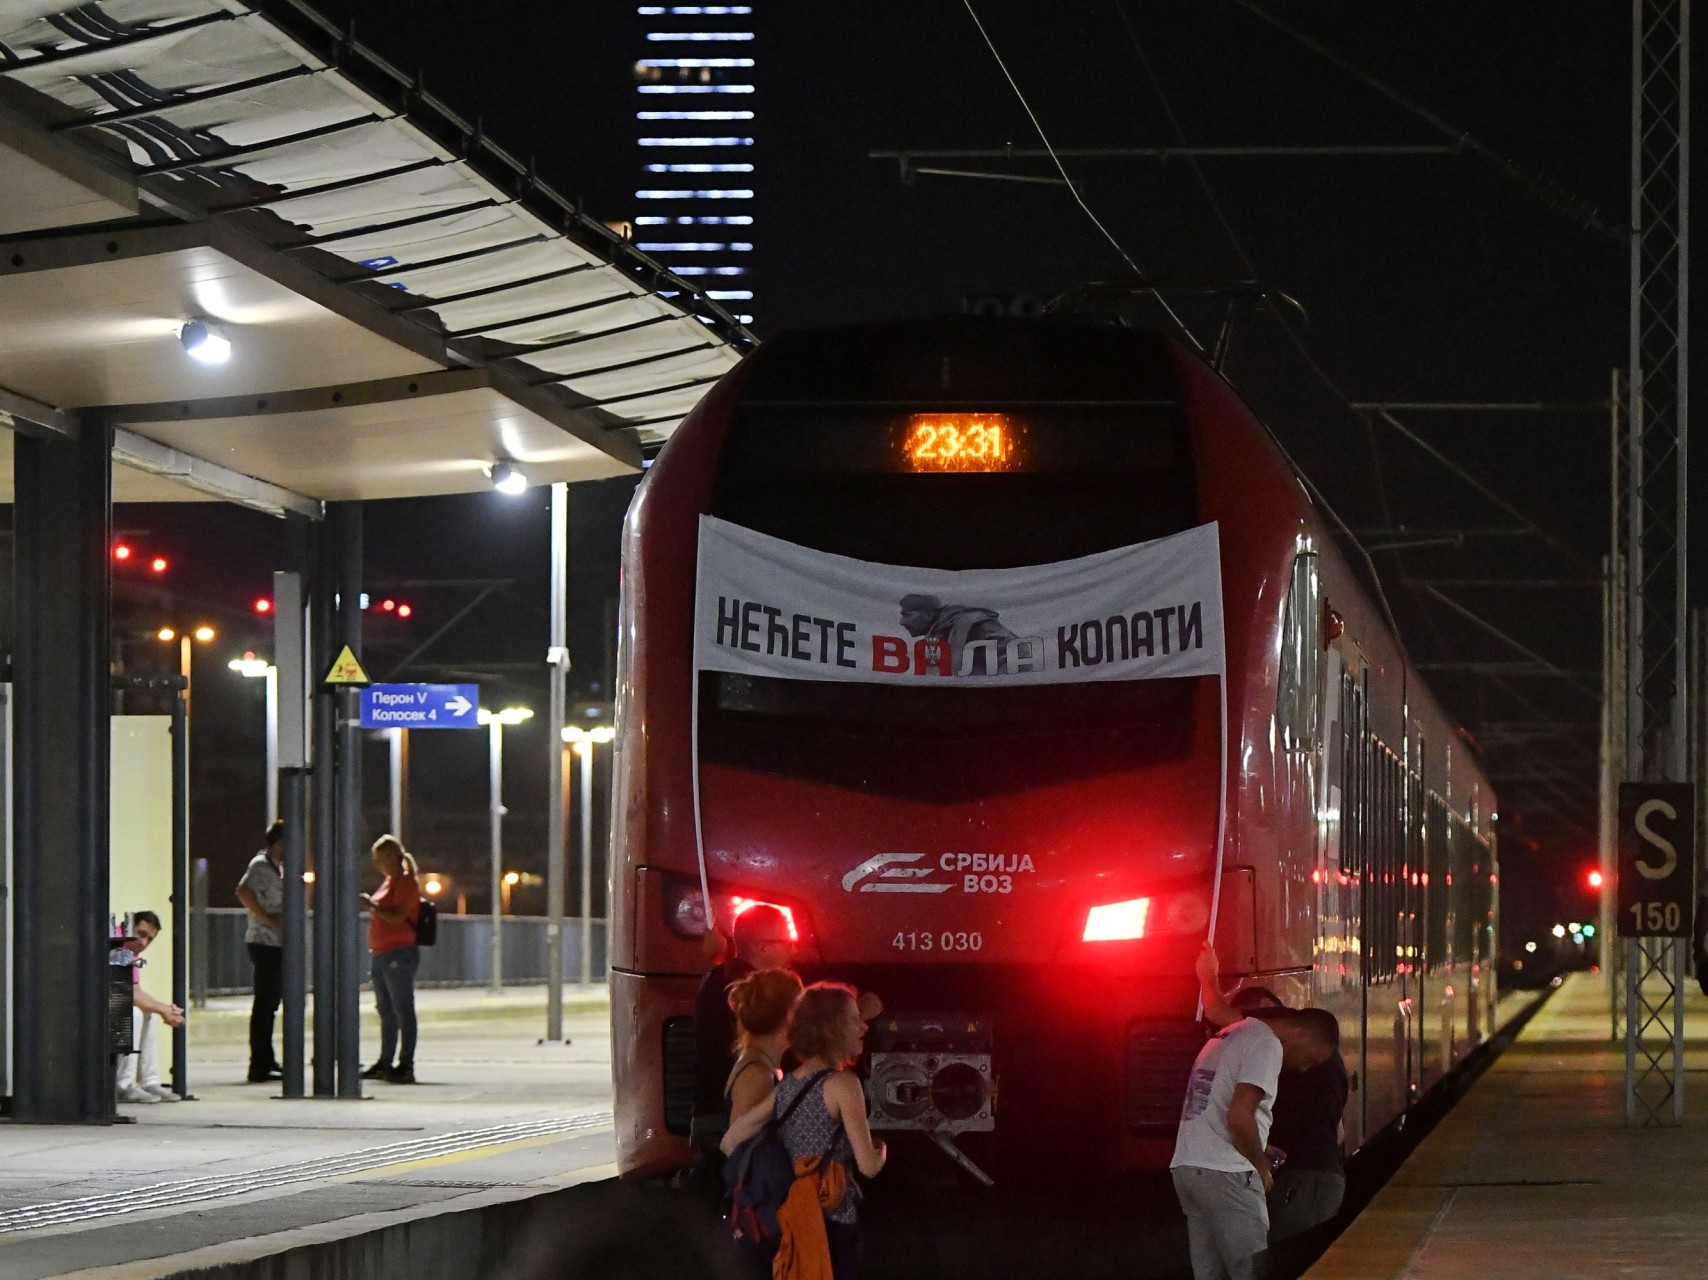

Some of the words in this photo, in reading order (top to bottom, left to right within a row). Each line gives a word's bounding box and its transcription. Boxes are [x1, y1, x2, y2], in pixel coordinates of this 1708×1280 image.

[914, 424, 1001, 458] 23:31
[716, 596, 857, 669] НЕЋЕТЕ
[871, 634, 1045, 678] ВАЛА
[1057, 600, 1204, 670] КОПАТИ
[372, 692, 414, 706] Перон
[372, 708, 426, 721] Колосек
[428, 708, 437, 721] 4
[1634, 798, 1678, 881] S
[939, 853, 1036, 873] СРБИЈА
[963, 874, 1013, 894] ВОЗ
[1629, 901, 1682, 932] 150
[892, 931, 934, 952] 413
[940, 931, 983, 952] 030
